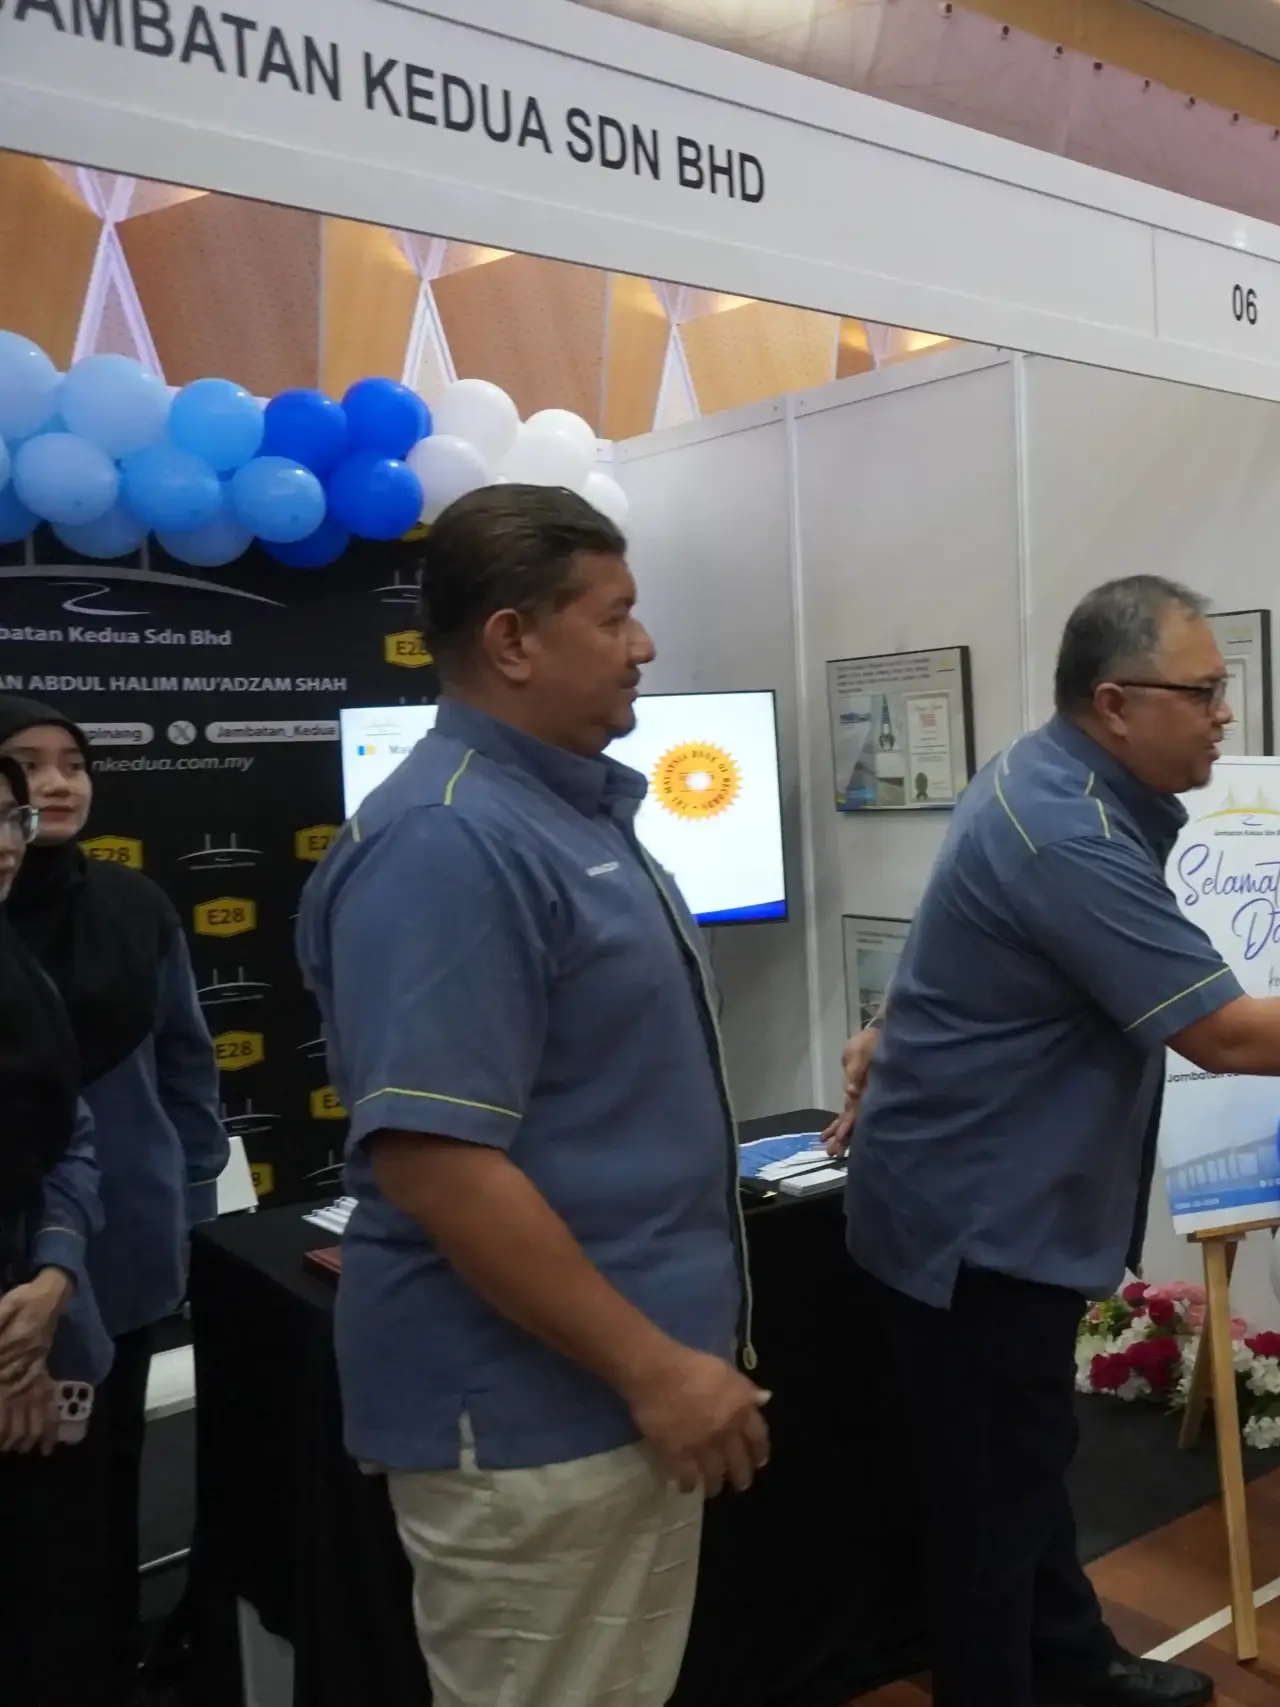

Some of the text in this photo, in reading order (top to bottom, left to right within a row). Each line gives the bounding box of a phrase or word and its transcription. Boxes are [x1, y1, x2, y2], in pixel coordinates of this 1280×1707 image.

[363, 52, 552, 154] KEDUA
[565, 107, 661, 181] SDN
[676, 135, 765, 203] BHD
[1232, 284, 1258, 325] 06
[68, 627, 140, 643] Kedua
[144, 629, 186, 645] Sdn
[190, 630, 232, 646] Bhd
[28, 676, 106, 691] ABDUL
[109, 677, 179, 692] HALIM
[182, 677, 292, 692] MU'ADZAM
[295, 677, 347, 692] SHAH
[207, 907, 245, 926] E28
[215, 1040, 254, 1060] E28
